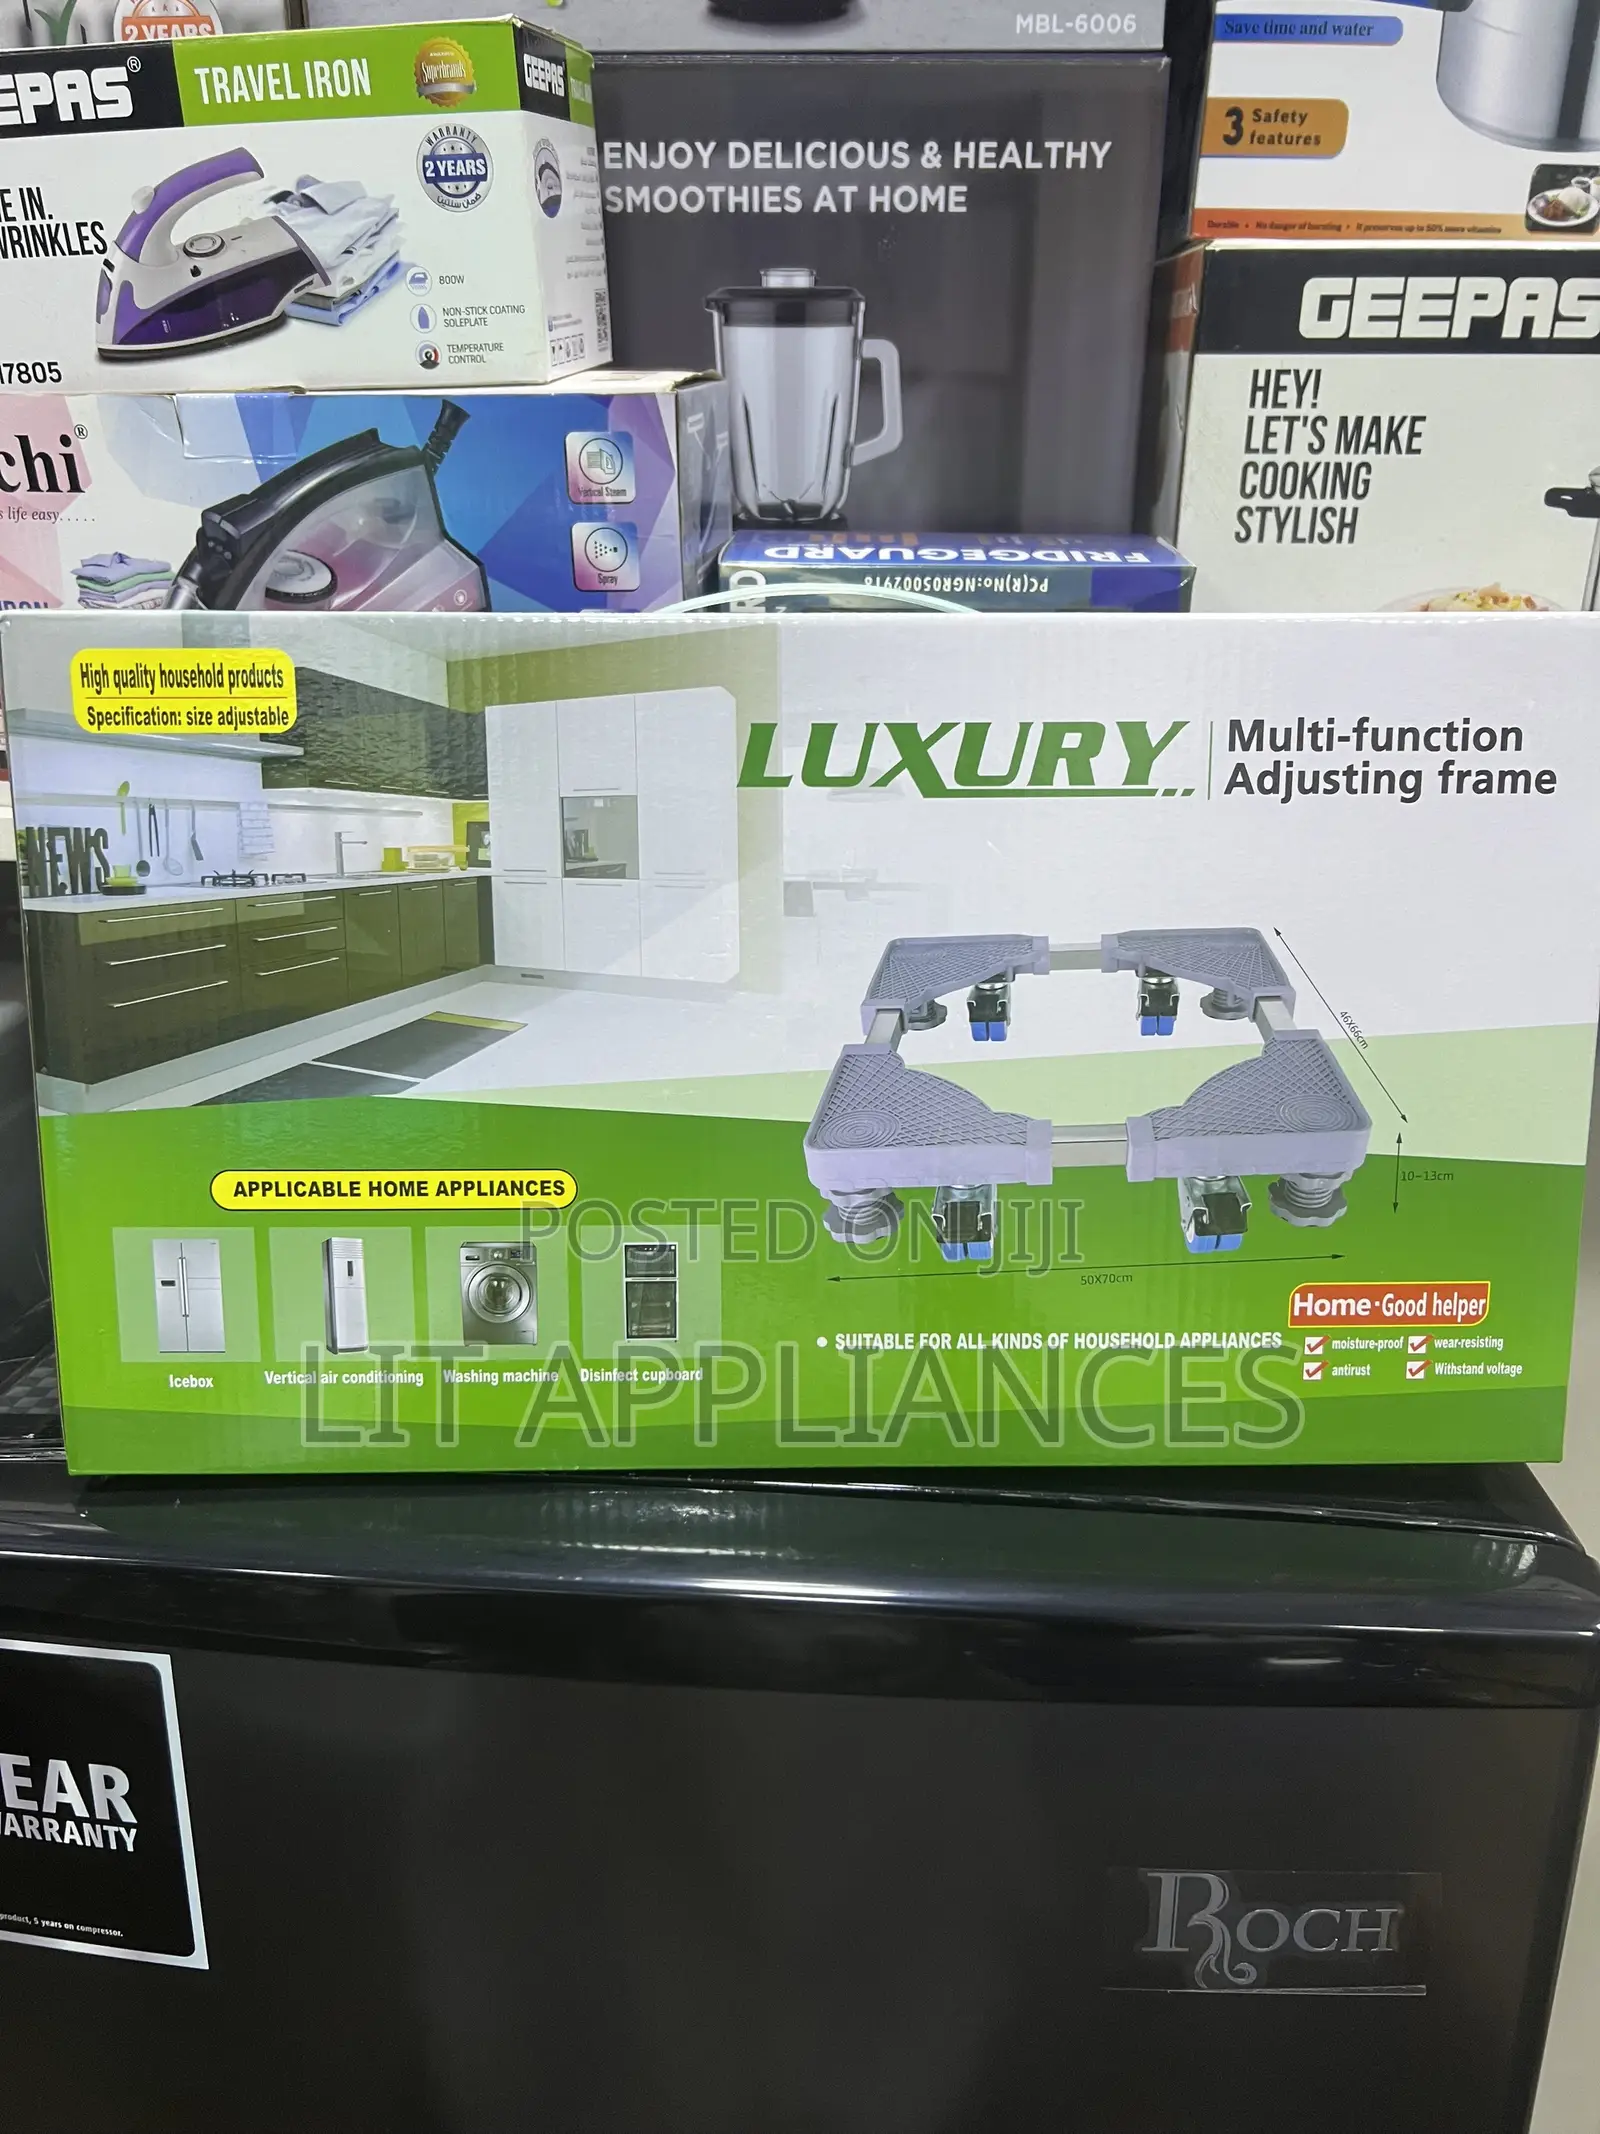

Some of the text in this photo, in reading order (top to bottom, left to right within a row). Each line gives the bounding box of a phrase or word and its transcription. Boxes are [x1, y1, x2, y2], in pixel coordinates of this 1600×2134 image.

[124, 24, 139, 41] 2
[1016, 13, 1137, 35] MBL-6006
[1224, 20, 1375, 37] Save time and water
[194, 58, 372, 104] TRAVEL IRON
[421, 60, 466, 83] Superbrands
[523, 53, 565, 98] GEEPAS
[1222, 106, 1244, 146] 3
[1252, 108, 1308, 126] Safety
[426, 125, 478, 147] WARRANTY
[1249, 130, 1322, 146] features
[603, 140, 1113, 169] ENJOY DELICIOUS & HEALTHY
[425, 158, 487, 178] 2 YEARS
[19, 187, 53, 221] IN.
[604, 185, 968, 213] SMOOTHIES AT HOME
[439, 275, 464, 285] 800W
[442, 305, 525, 316] NON-STICK COATING
[1299, 277, 1600, 339] GEEPAS
[444, 318, 488, 327] SOLEPLATE
[447, 343, 504, 353] TEMPERATURE
[448, 355, 486, 364] CONTROL
[1249, 369, 1322, 409] HEY!
[1244, 416, 1427, 455] LET'S MAKE
[1239, 462, 1372, 500] COOKING
[8, 506, 28, 524] life
[1234, 507, 1359, 544] STYLISH
[764, 545, 1151, 563] FRIDGEGUARD
[598, 573, 618, 585] Spray
[79, 663, 284, 695] High quality household products
[87, 706, 290, 731] Specification: size adjustable
[1227, 718, 1524, 753] Multi-function
[737, 721, 1192, 798] LUXURY
[1224, 759, 1558, 804] Adjusting frame
[26, 826, 110, 897] NEWS
[1338, 1010, 1370, 1050] 46X66cm
[233, 1178, 567, 1199] APPLICABLE HOME APPLIANCES
[1080, 1272, 1133, 1286] 50X70cm
[1292, 1293, 1371, 1317] Home
[1432, 1292, 1487, 1323] helper
[835, 1331, 1282, 1350] SUITABLE FOR ALL KINDS OF HOUSEHOLD APPLIANCES
[1332, 1336, 1404, 1352] moisture-proof
[1434, 1335, 1504, 1351] wear-resisting
[264, 1369, 424, 1386] Vertical air conditioning
[443, 1369, 559, 1386] Washing machine
[580, 1367, 704, 1385] Disinfect cupboard
[1331, 1363, 1371, 1376] antirust
[1434, 1362, 1523, 1378] Withstand voltage
[168, 1374, 214, 1389] Icebox
[0, 1754, 138, 1824] EAR
[0, 1811, 137, 1852] ARRANTY
[41, 1918, 63, 1929] years
[64, 1922, 74, 1930] on
[76, 1925, 124, 1938] compressor.
